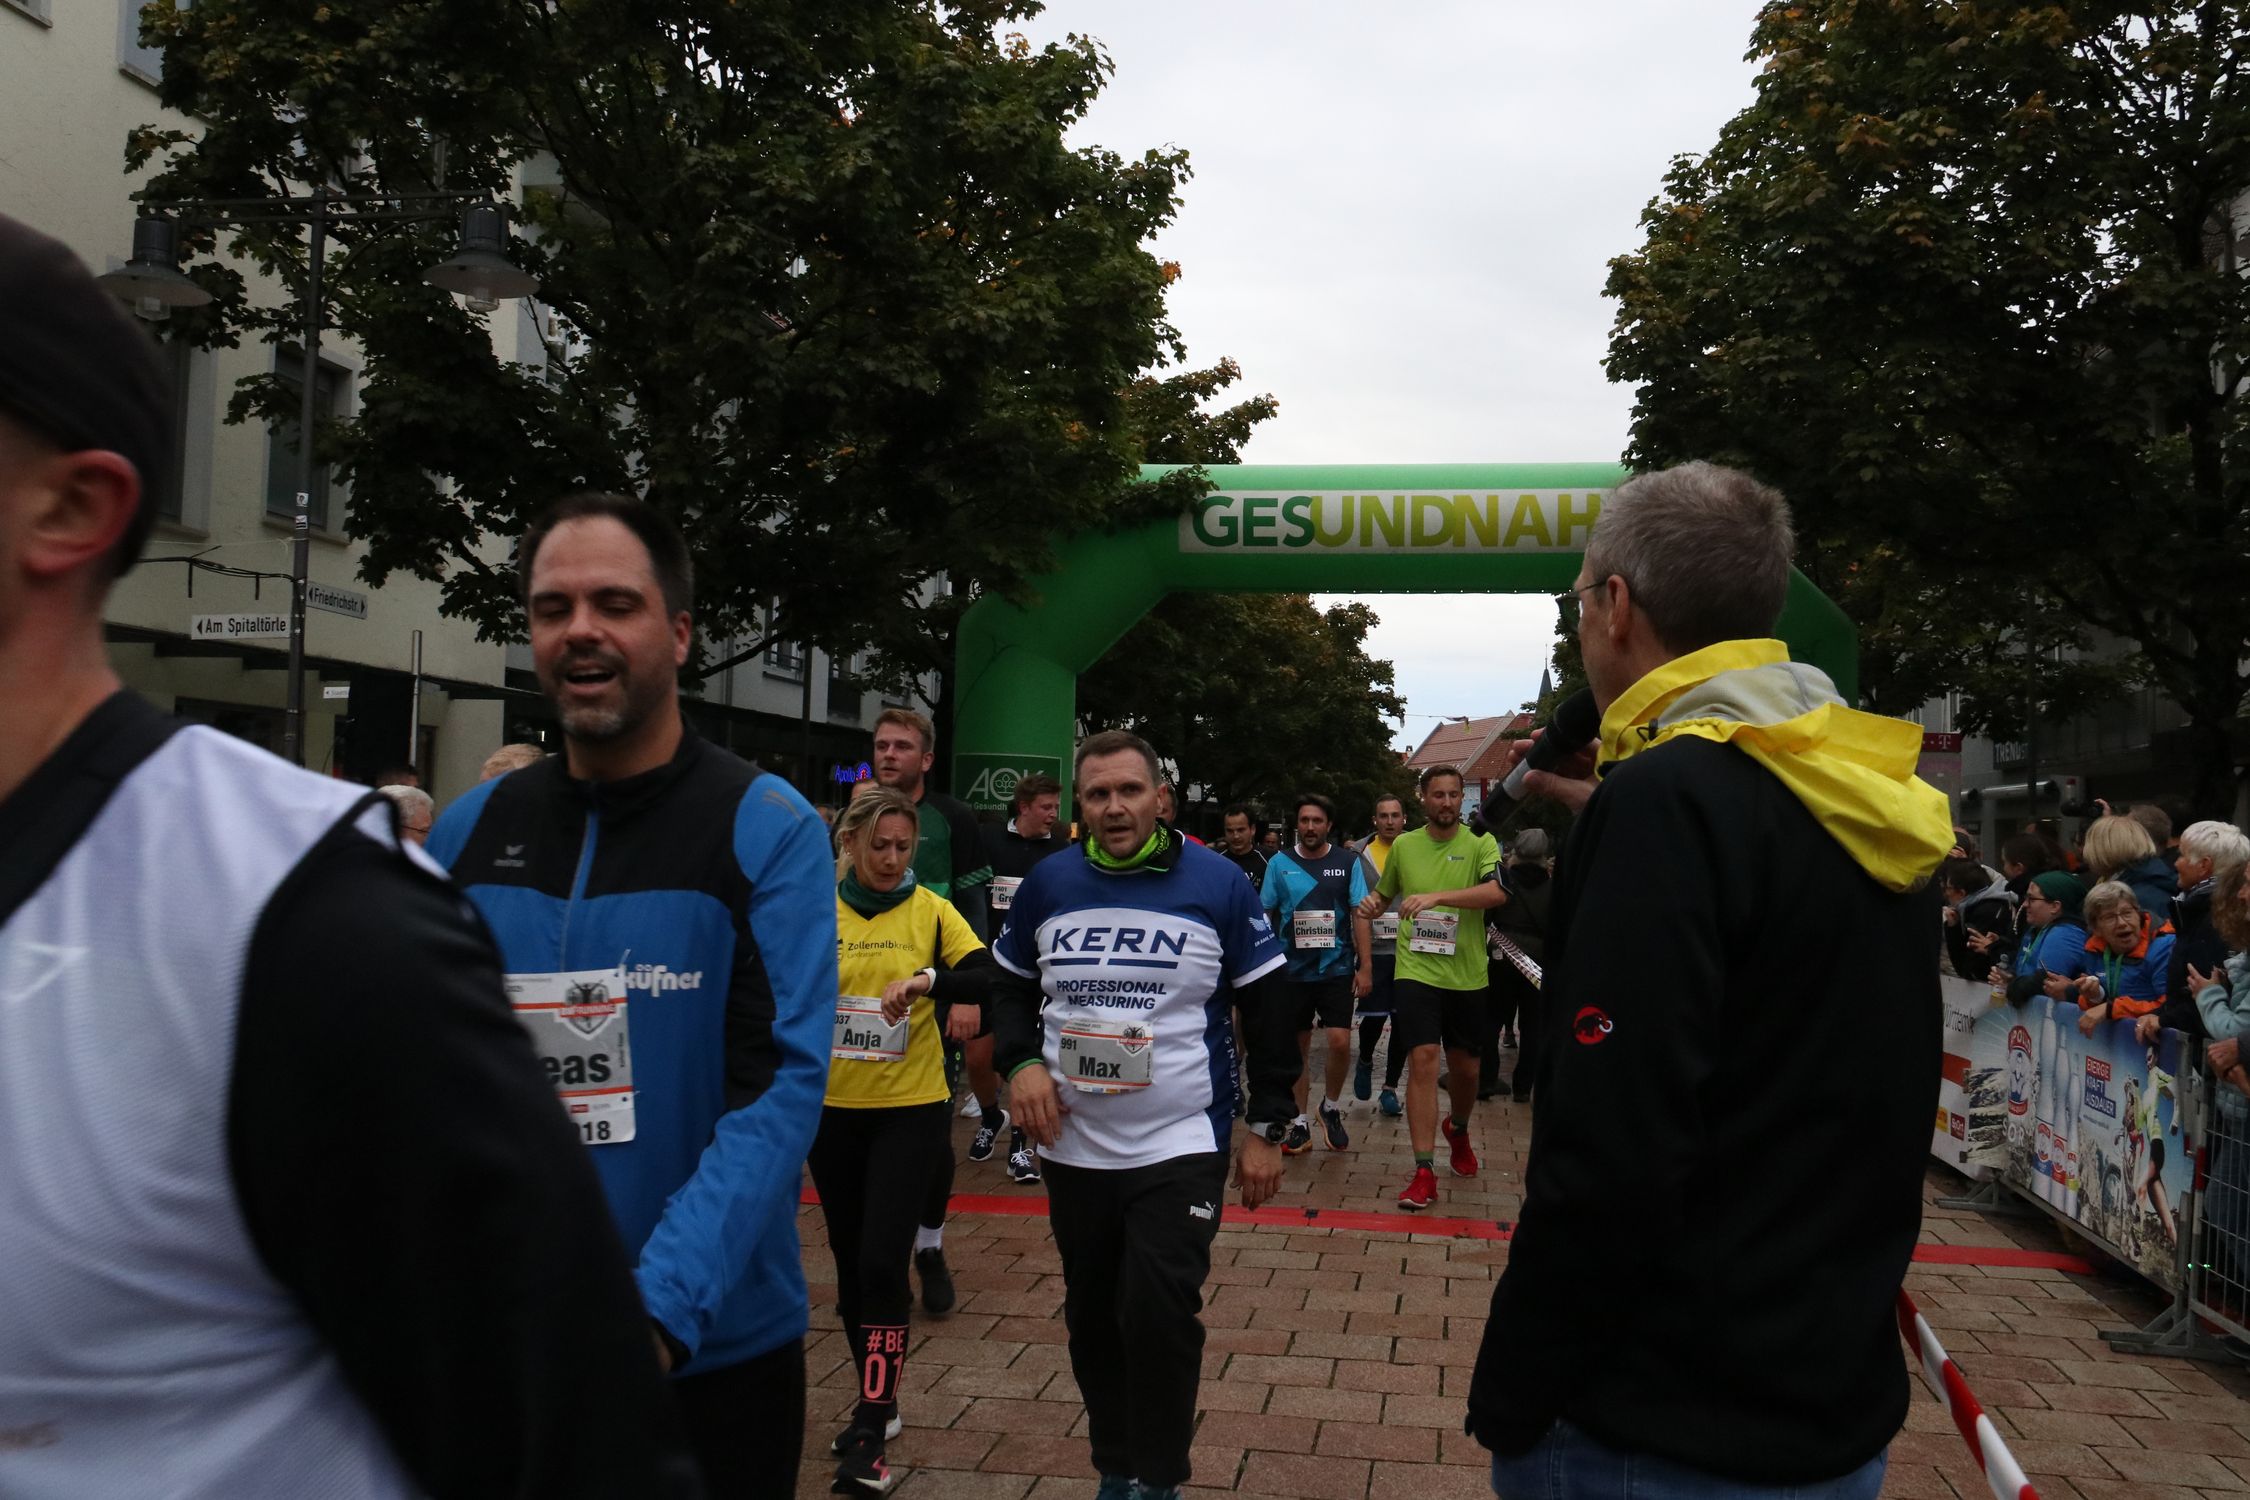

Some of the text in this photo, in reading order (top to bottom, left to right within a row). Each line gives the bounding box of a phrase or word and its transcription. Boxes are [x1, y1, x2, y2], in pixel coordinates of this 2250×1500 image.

[1192, 493, 1600, 548] GESUNDNAH
[314, 587, 360, 613] Friedrichstr.
[205, 617, 286, 636] Am Spitaltörle
[1323, 869, 1345, 877] RIDI
[1295, 927, 1333, 935] Christian
[1416, 927, 1448, 940] Tobias
[1051, 927, 1188, 956] KERN
[1056, 979, 1167, 995] PROFESSIONAL
[1067, 994, 1156, 1010] MEASURING
[842, 1028, 881, 1050] Anja
[1061, 1037, 1077, 1051] 991
[1079, 1055, 1121, 1079] Max
